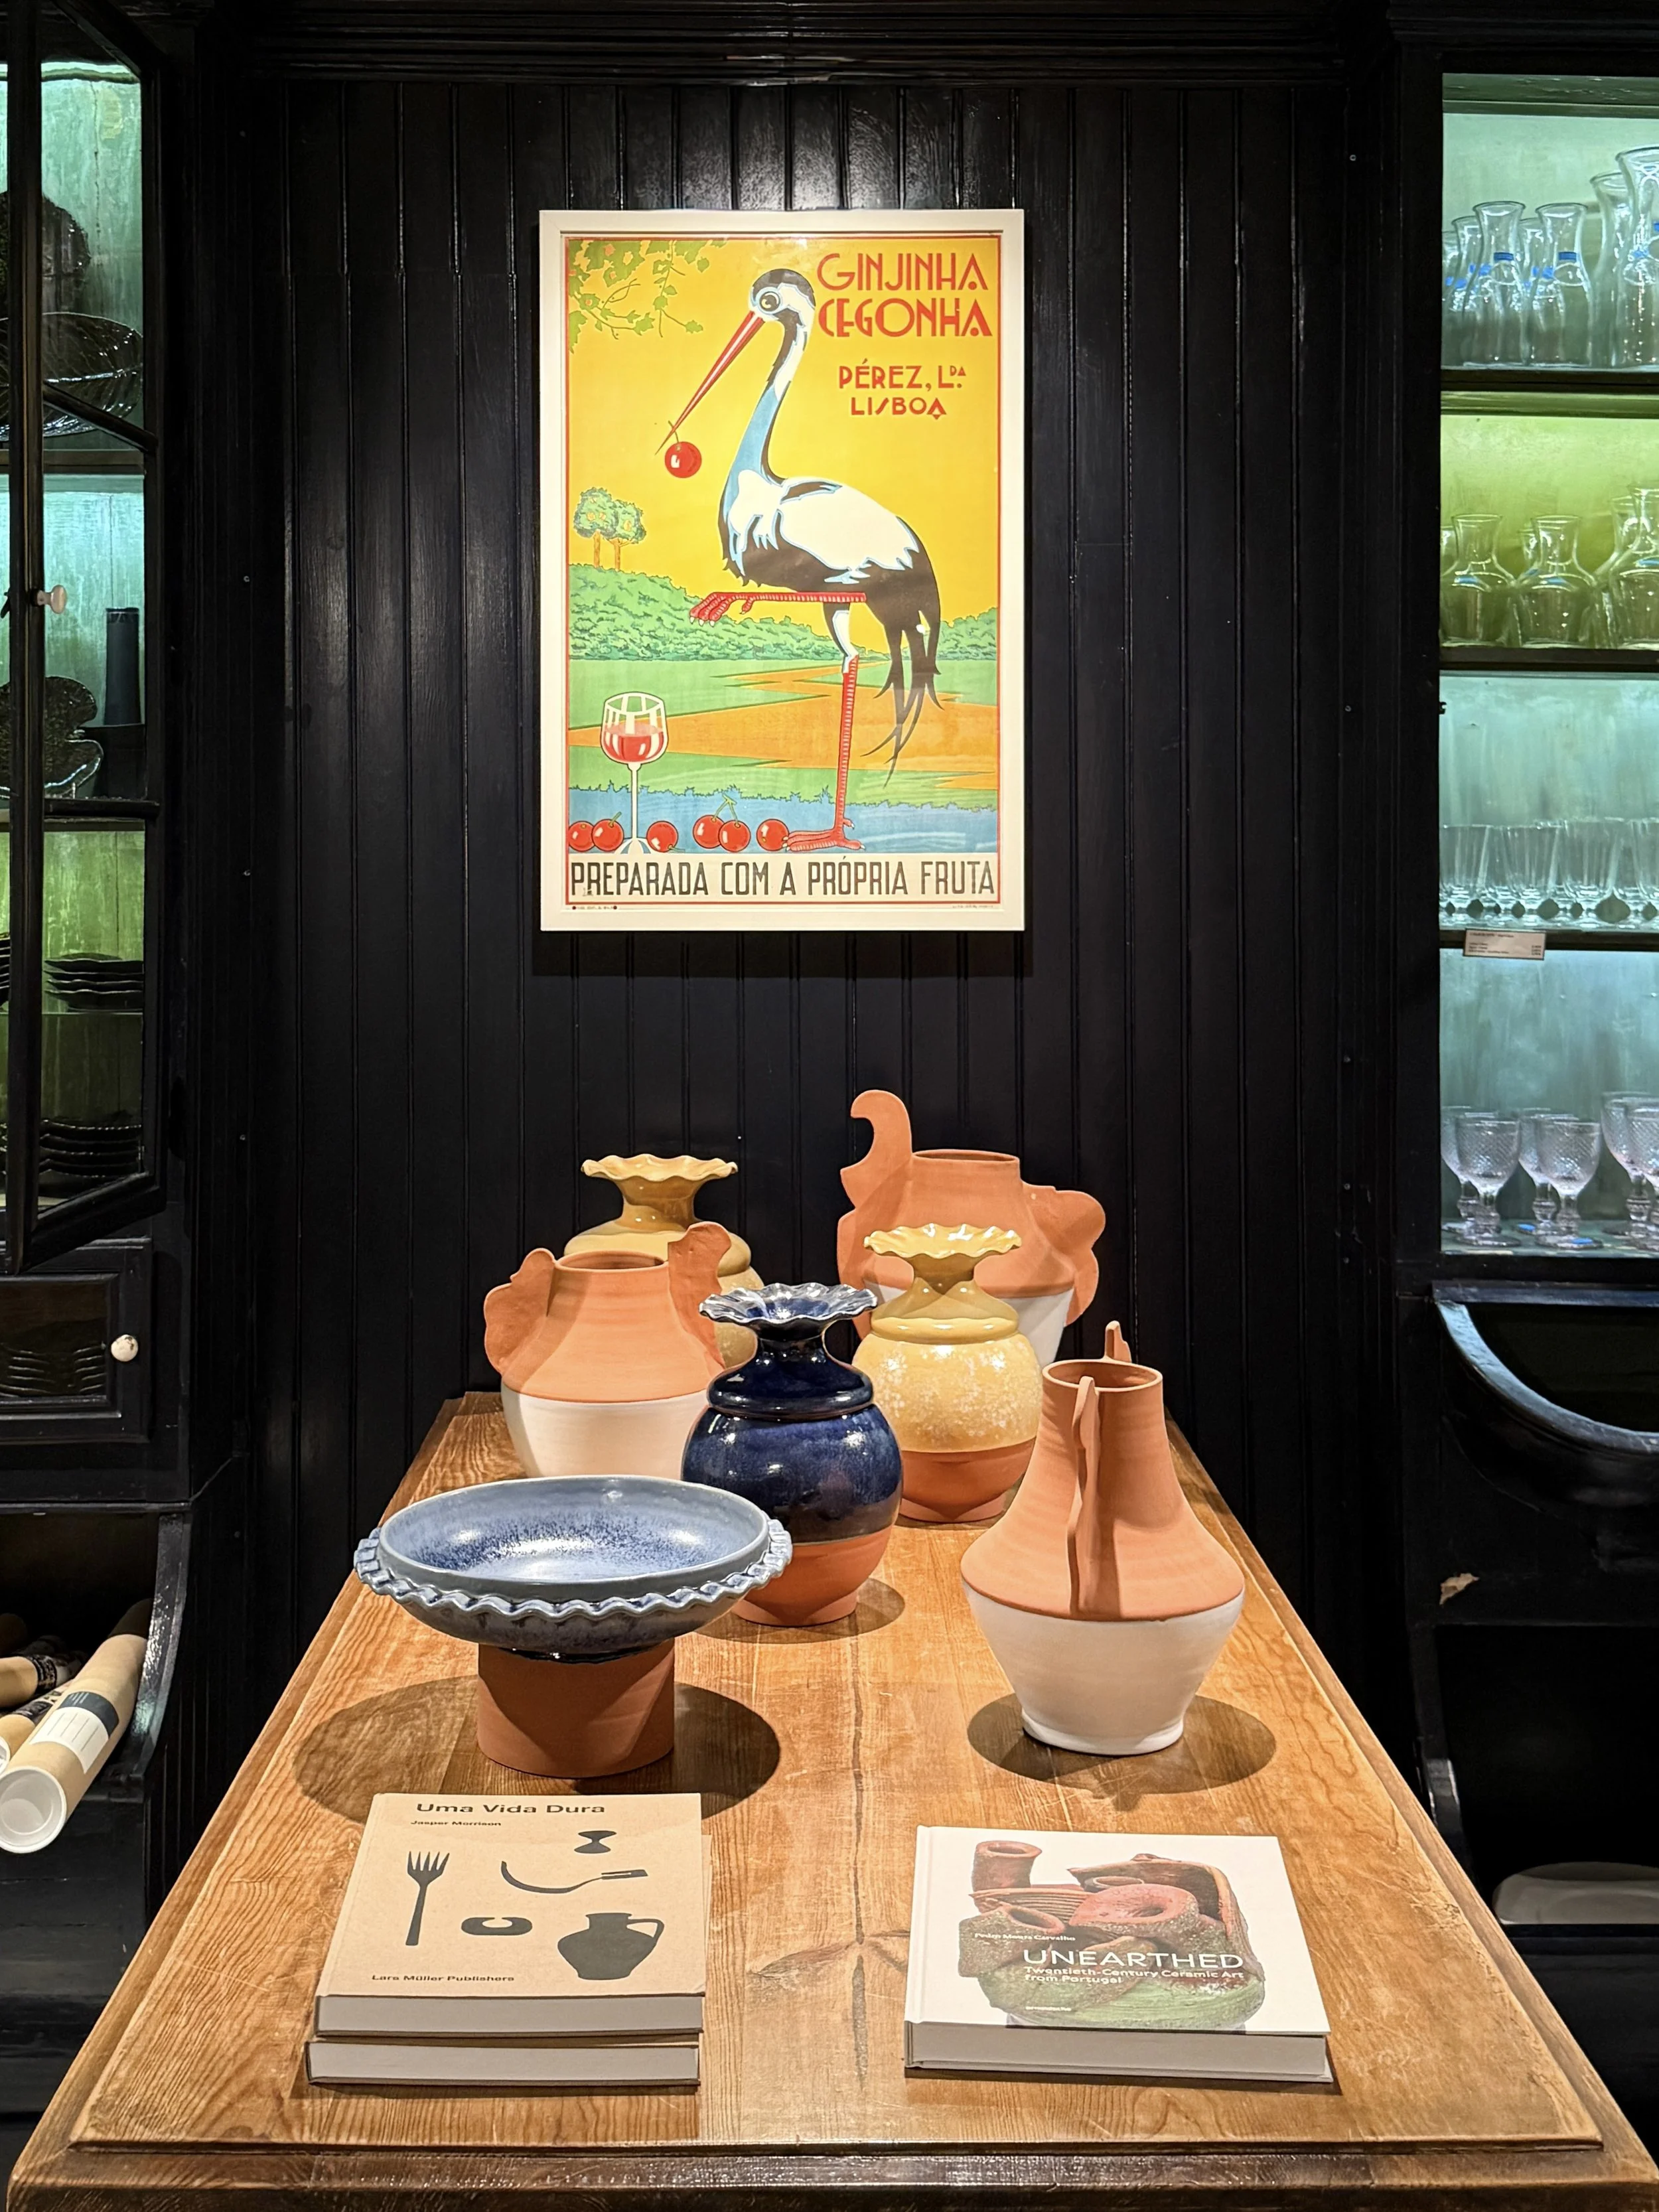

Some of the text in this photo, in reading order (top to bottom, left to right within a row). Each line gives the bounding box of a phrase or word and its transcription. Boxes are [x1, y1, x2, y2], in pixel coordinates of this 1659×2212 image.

[817, 253, 989, 291] GINJINHA
[818, 297, 993, 337] CEGONHA
[839, 358, 932, 392] PÉREZ,
[851, 397, 947, 420] LISBOA
[571, 855, 995, 895] PREPARADA COM A PRÓPRIA FRUTA
[417, 1803, 605, 1813] Uma Vida Dura
[1023, 1949, 1244, 1968] UNEARTHED
[1023, 1966, 1159, 1978] Twentieth-Century
[1025, 1974, 1122, 1985] from Portugal
